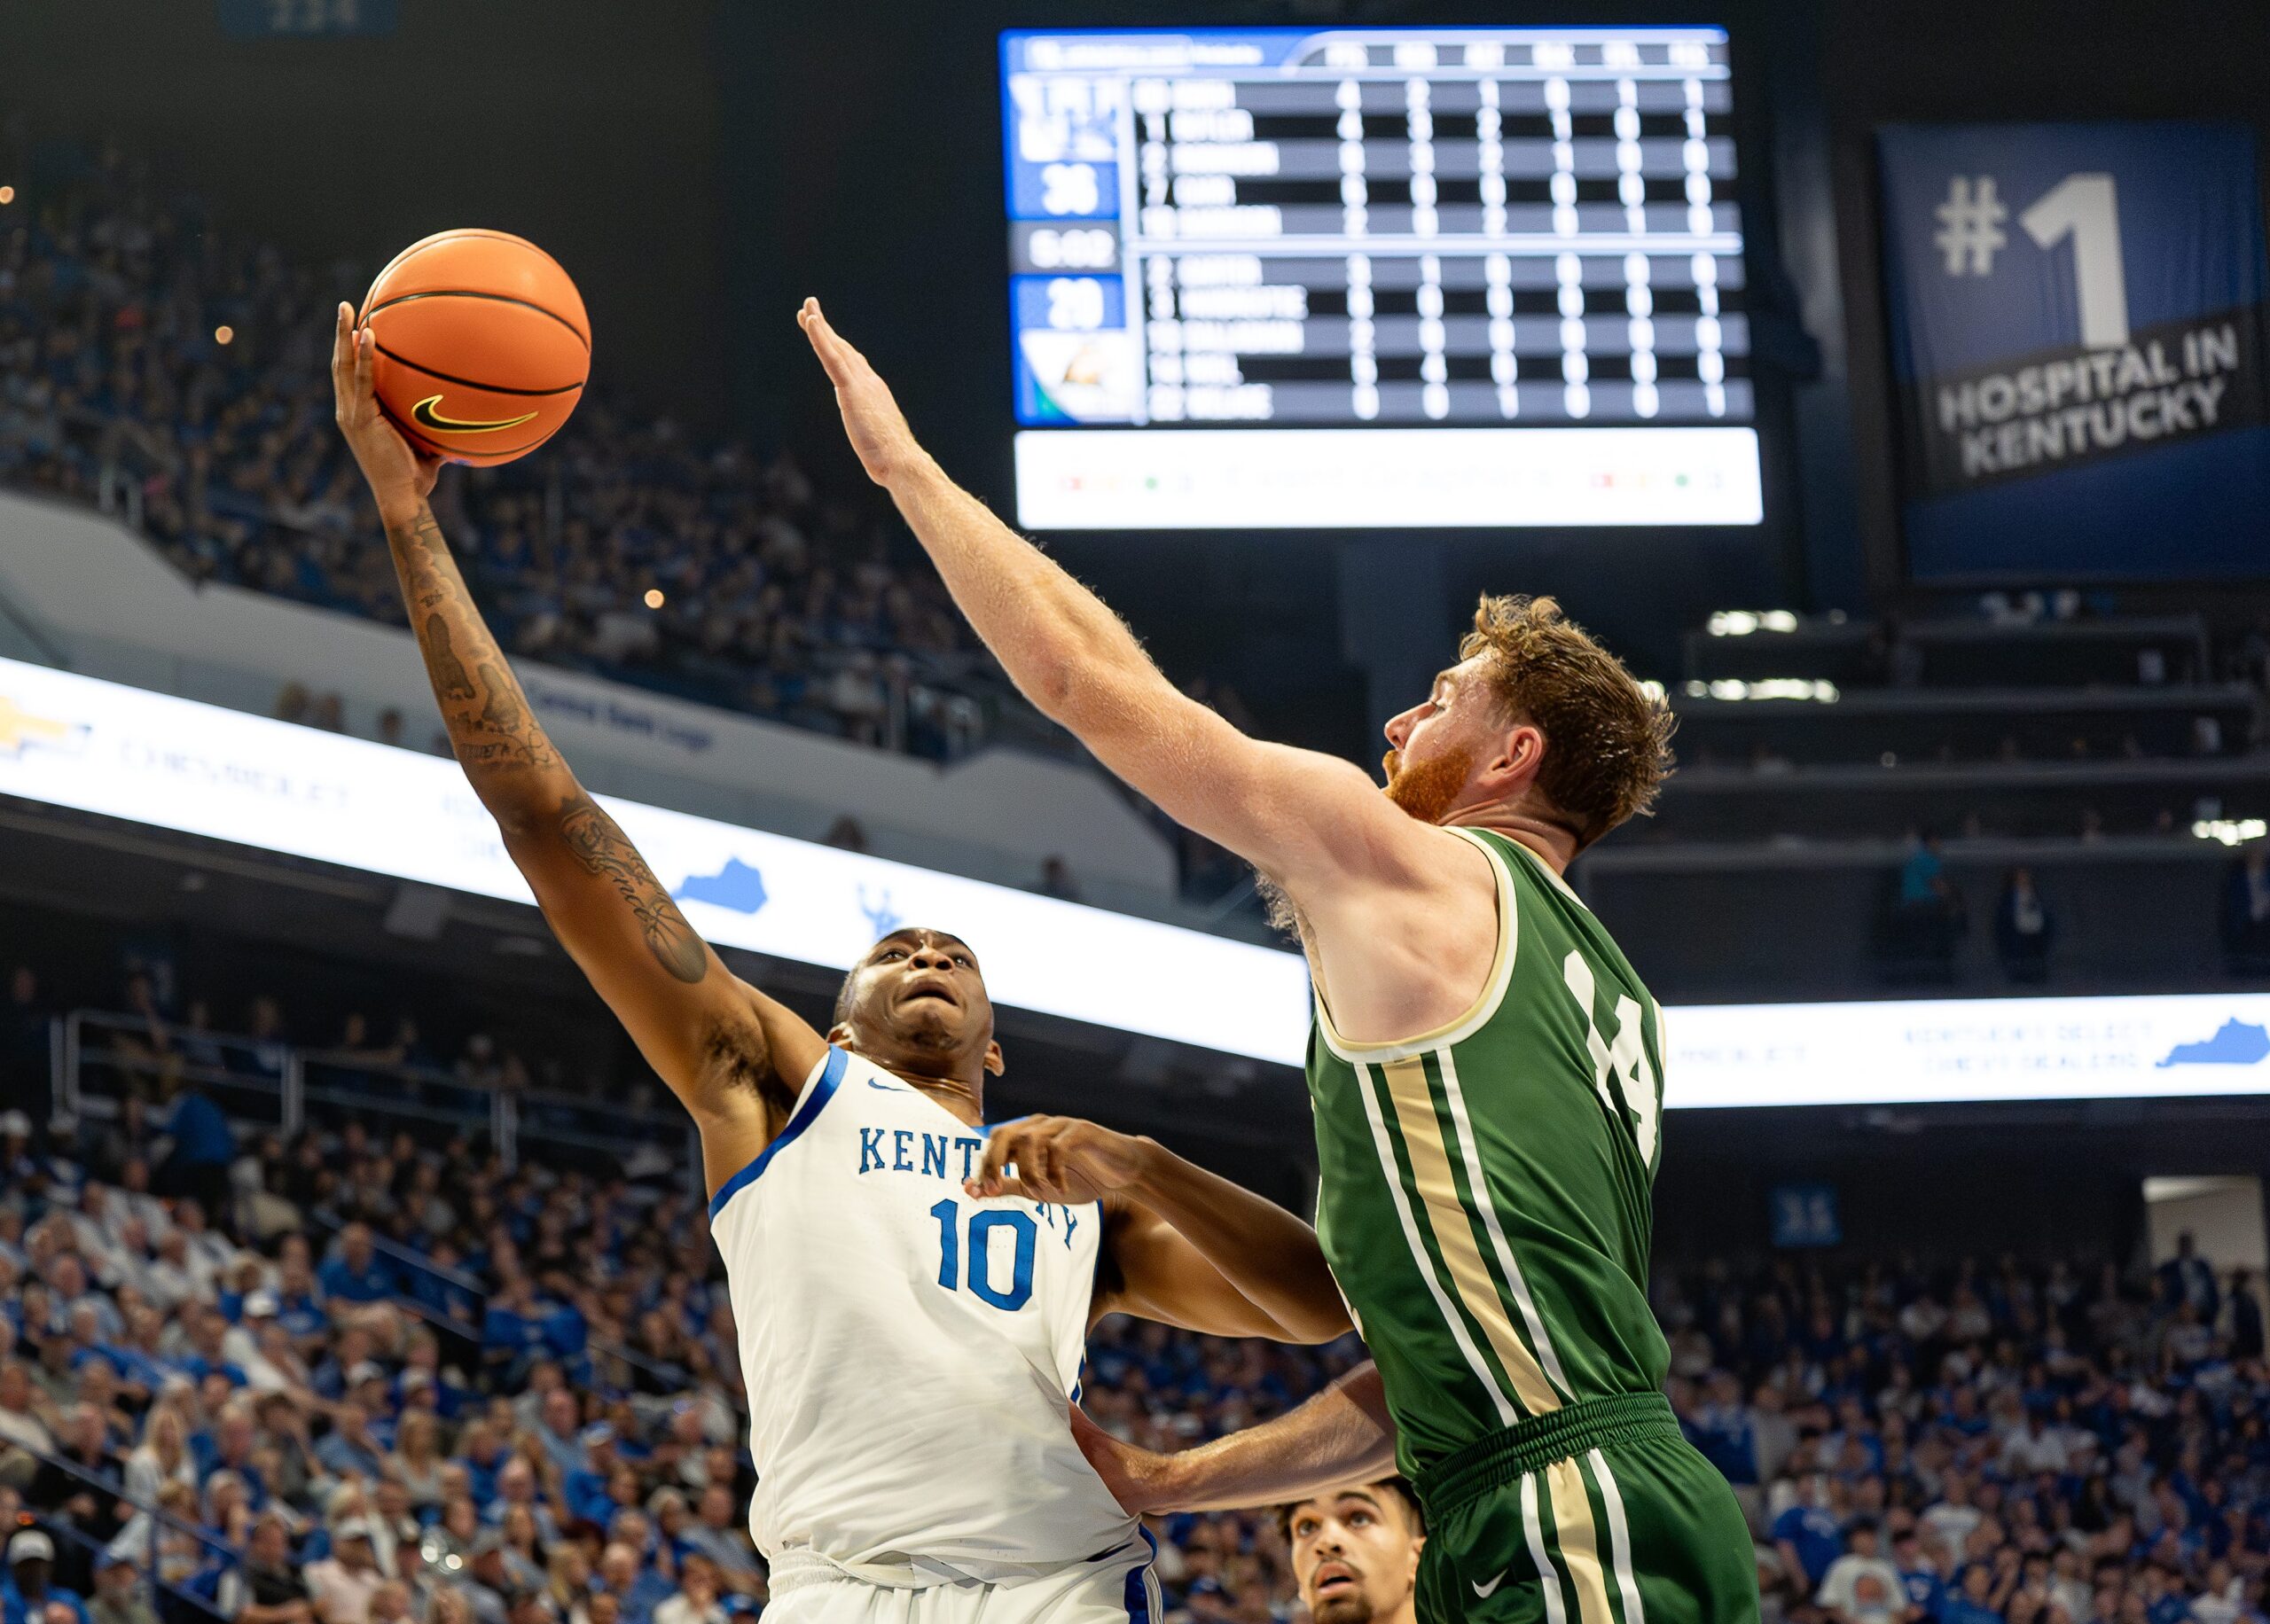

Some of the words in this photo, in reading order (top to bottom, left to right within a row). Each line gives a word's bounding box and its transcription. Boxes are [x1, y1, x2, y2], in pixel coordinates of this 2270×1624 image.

[1934, 173, 2129, 347] #1
[1939, 339, 2179, 433] HOSPITAL
[2182, 324, 2237, 377] IN
[1961, 378, 2225, 476] KENTUCKY
[1563, 949, 1658, 1170] 14
[930, 1198, 1037, 1311] 10
